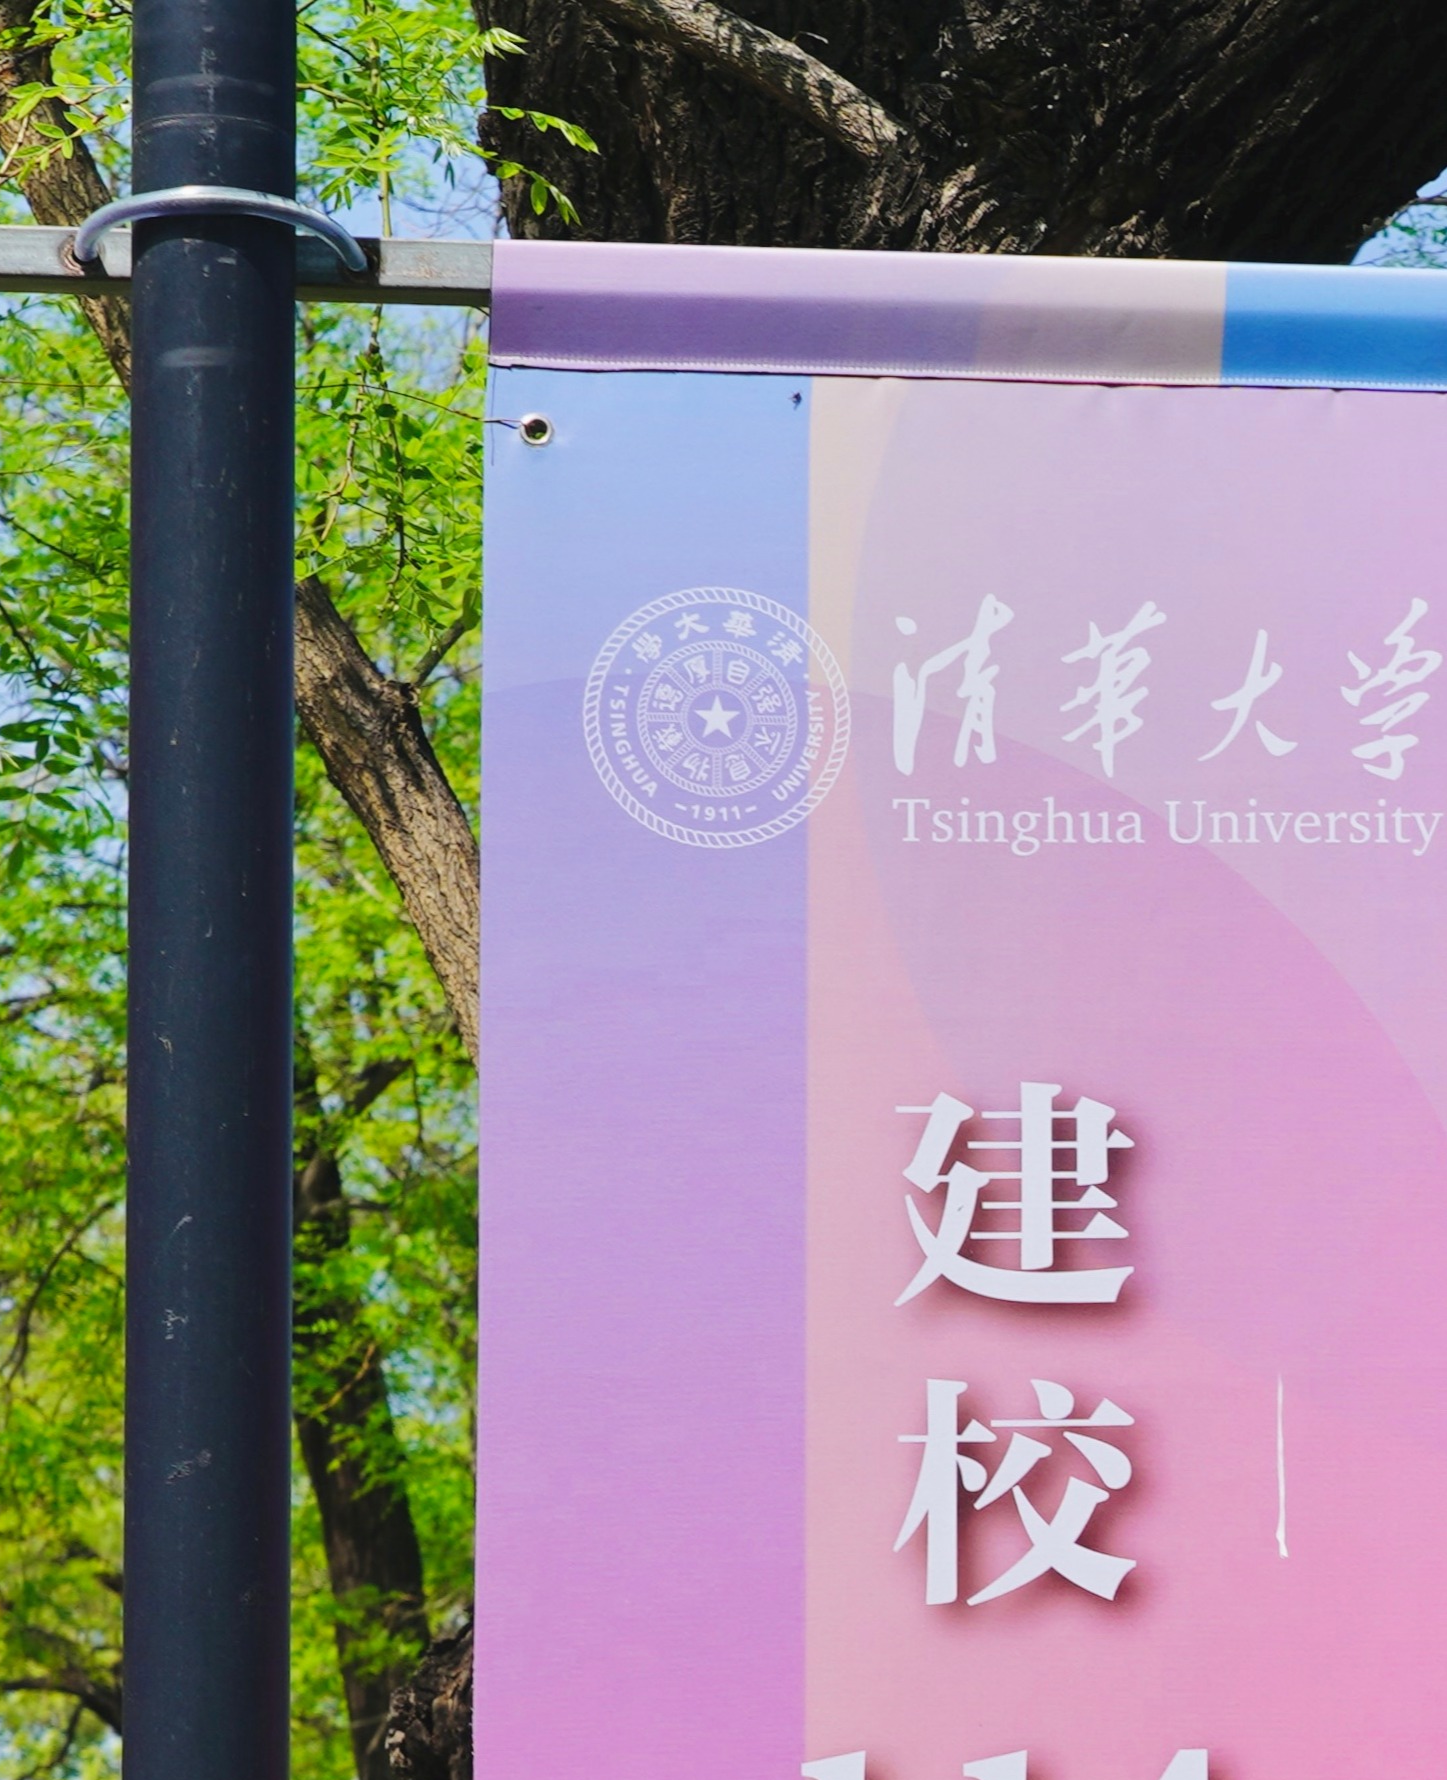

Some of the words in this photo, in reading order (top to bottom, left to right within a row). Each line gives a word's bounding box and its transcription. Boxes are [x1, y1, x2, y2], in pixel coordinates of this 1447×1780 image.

[610, 685, 658, 798] TSINGHUA
[772, 690, 824, 802] UNIVERSITY
[893, 797, 1143, 856] Tsinghua
[1165, 798, 1443, 856] University
